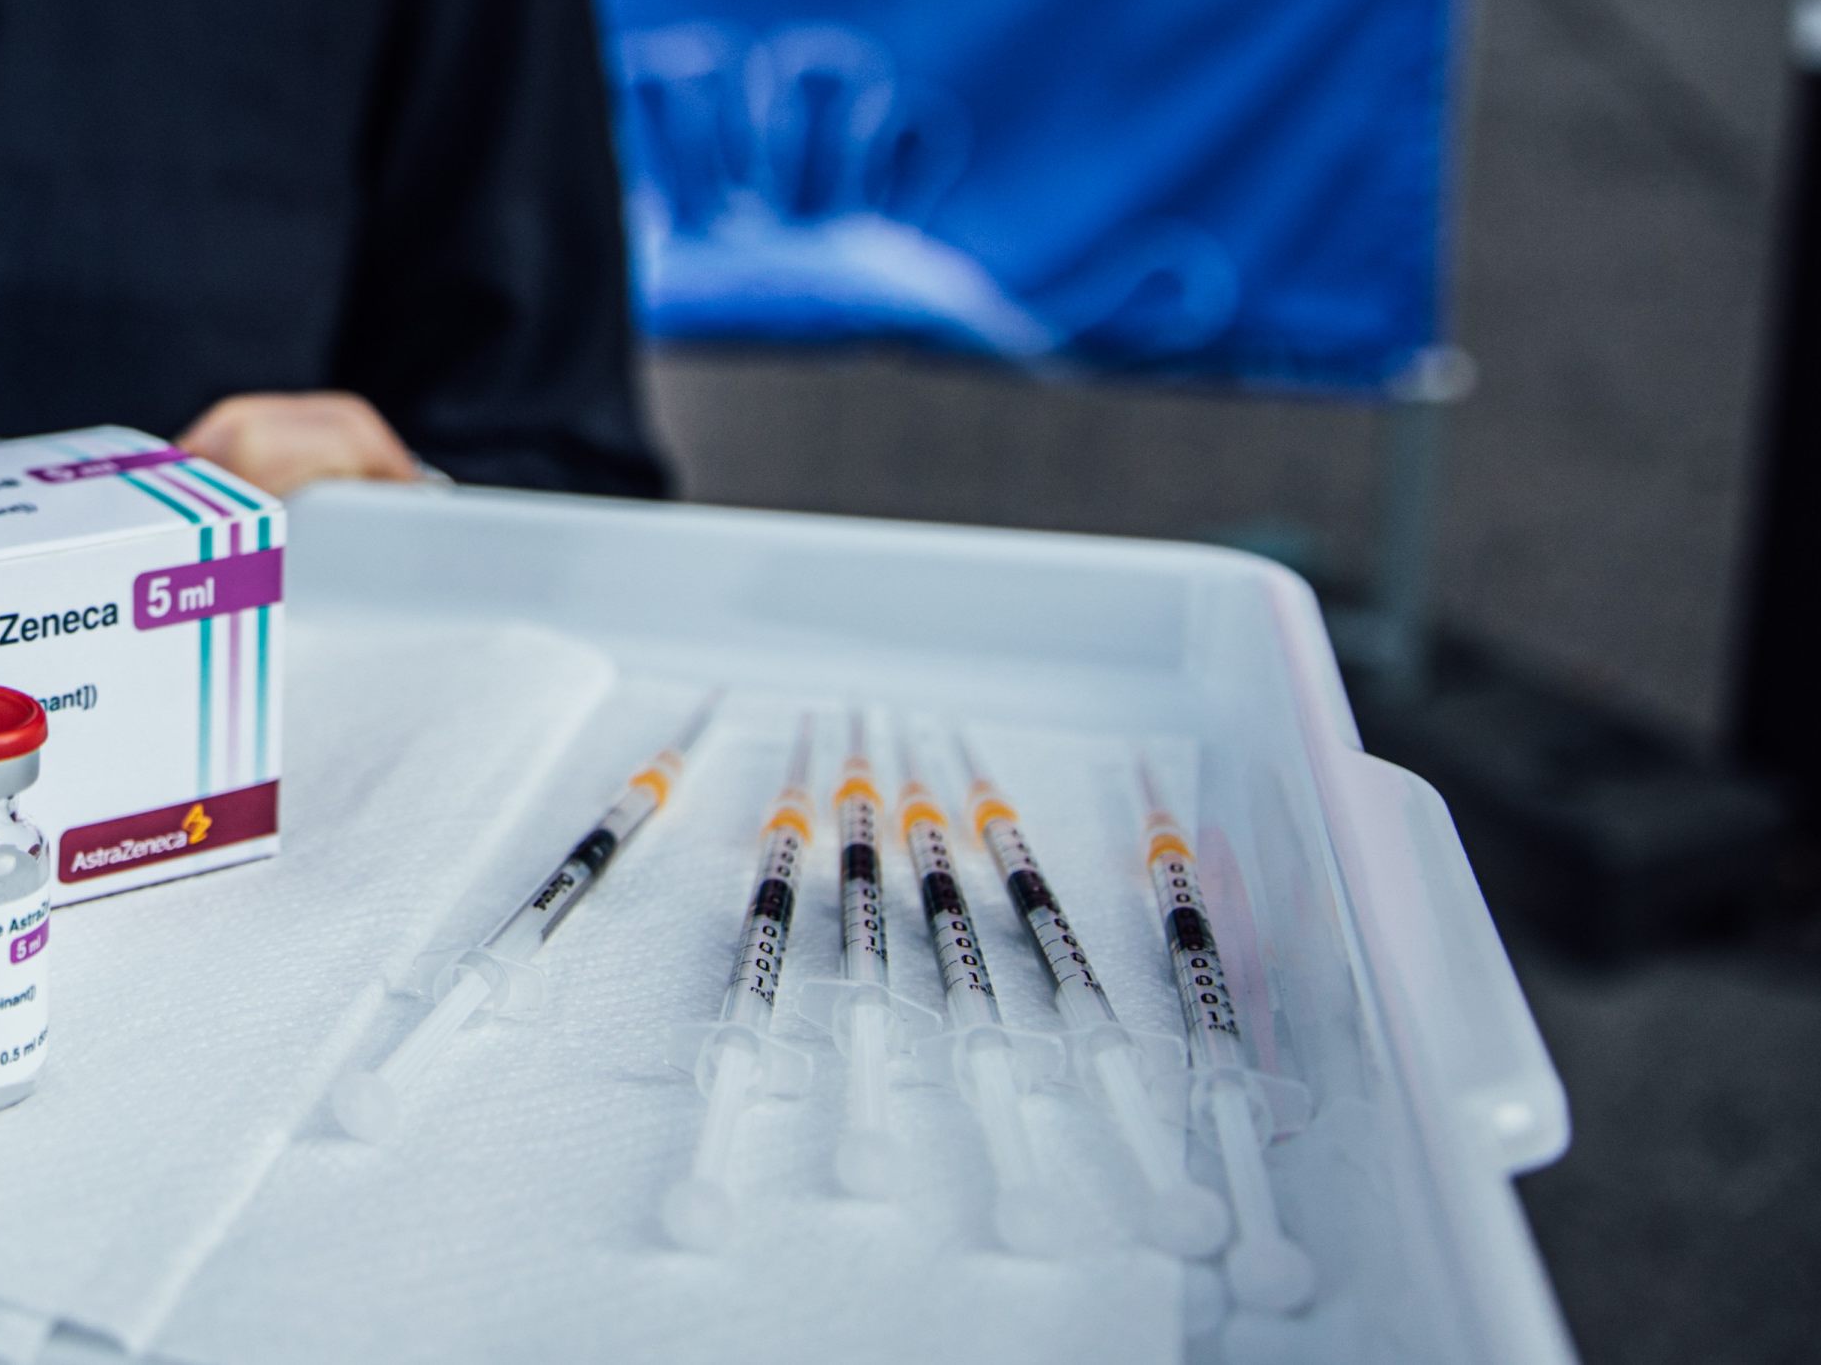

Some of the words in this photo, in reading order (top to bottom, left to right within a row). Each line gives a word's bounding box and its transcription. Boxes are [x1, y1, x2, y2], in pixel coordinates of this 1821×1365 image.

[146, 576, 173, 619] 5
[178, 576, 216, 613] ml
[70, 829, 189, 874] AstraZeneca
[15, 938, 28, 960] 5
[0, 1047, 20, 1066] 0.5
